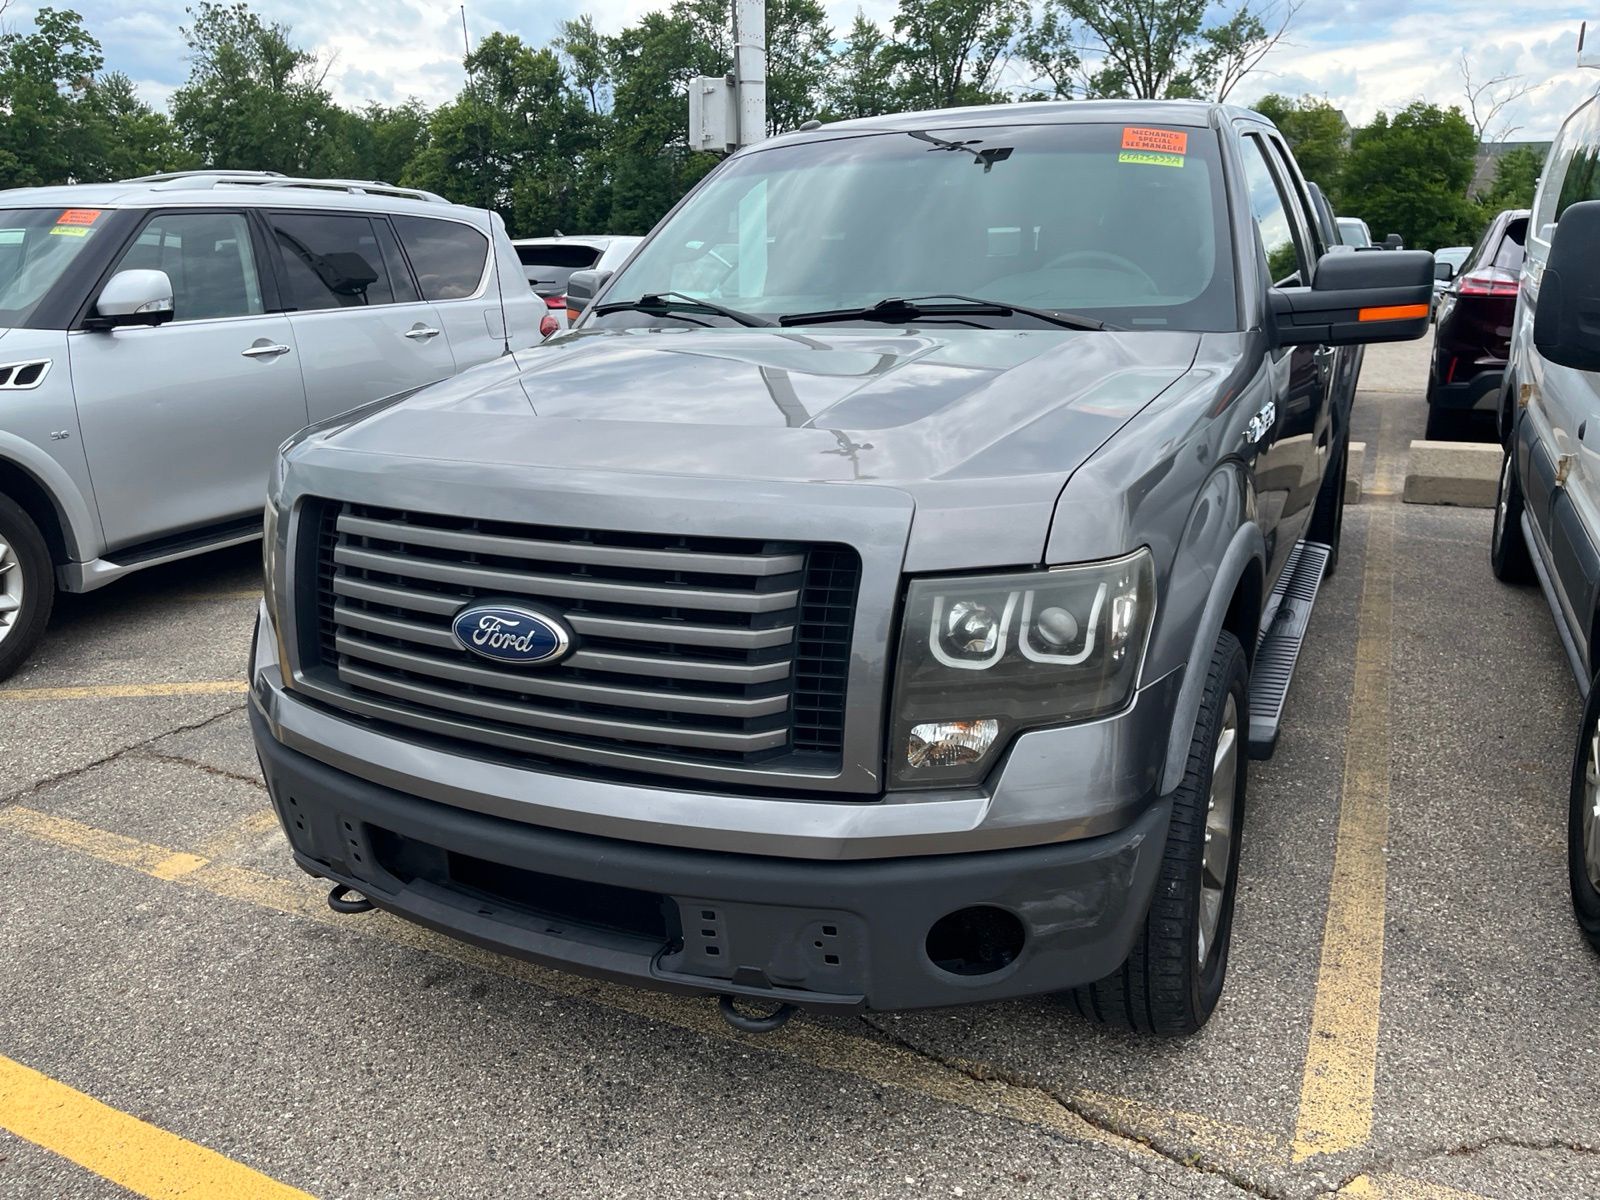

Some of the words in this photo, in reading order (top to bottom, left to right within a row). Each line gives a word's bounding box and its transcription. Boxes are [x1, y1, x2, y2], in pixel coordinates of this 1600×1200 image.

[1132, 129, 1180, 139] MECHANICS
[1138, 136, 1172, 144] SPECIAL
[1142, 142, 1183, 151] MANAGER
[472, 615, 535, 652] Ford
